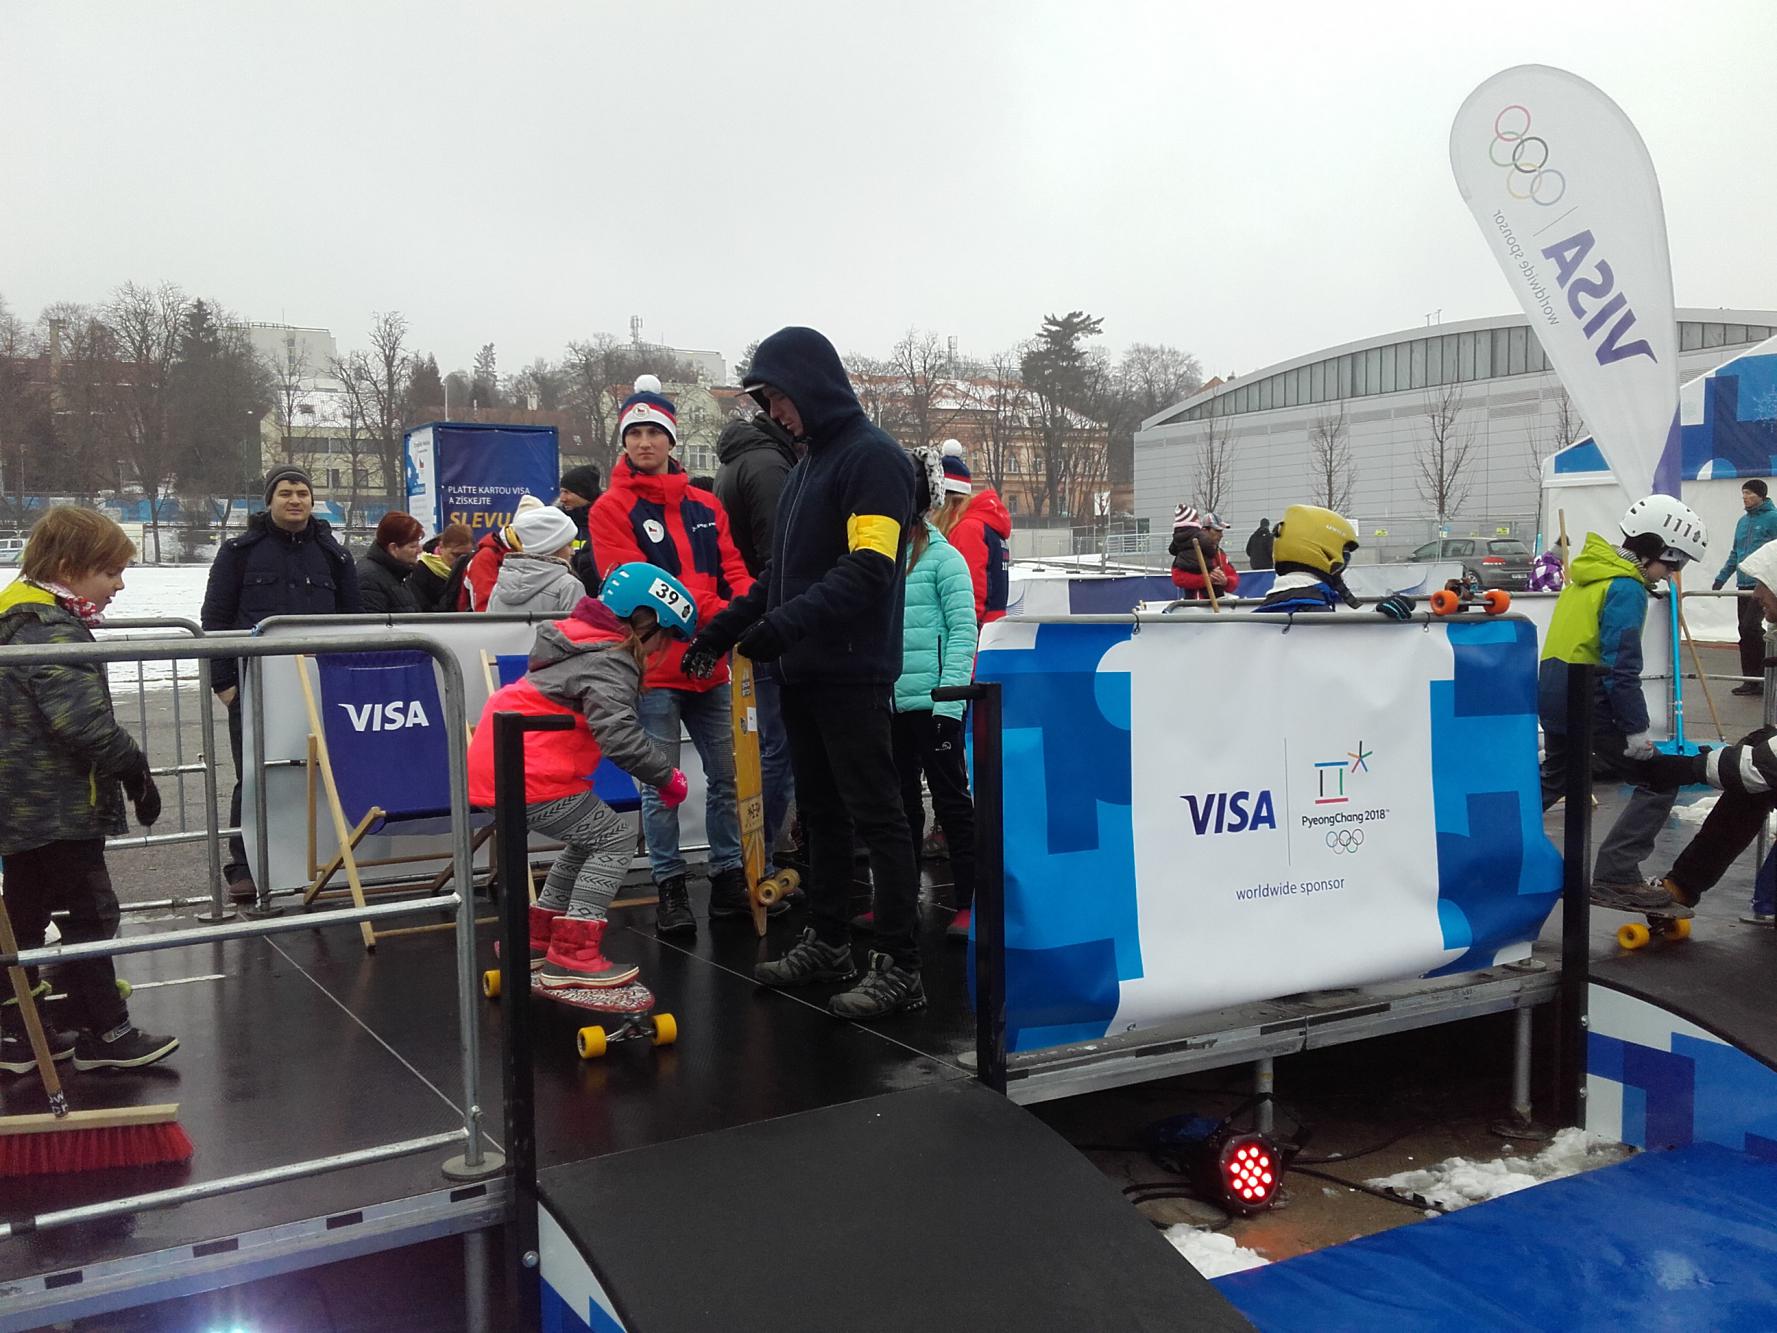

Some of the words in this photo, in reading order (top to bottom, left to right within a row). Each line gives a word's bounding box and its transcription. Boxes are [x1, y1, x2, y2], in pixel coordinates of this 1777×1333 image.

[448, 496, 455, 504] A
[456, 495, 492, 505] ZÍSKEJTE
[478, 486, 511, 495] KARTOU
[512, 487, 531, 495] VISA
[450, 511, 512, 528] SLEVU
[1663, 513, 1692, 537] 111
[655, 583, 679, 605] 39
[338, 700, 429, 732] VISA
[1179, 789, 1277, 836] VISA
[1301, 812, 1364, 828] PyeongChang
[1236, 881, 1297, 901] worldwide
[1300, 877, 1345, 895] sponsor
